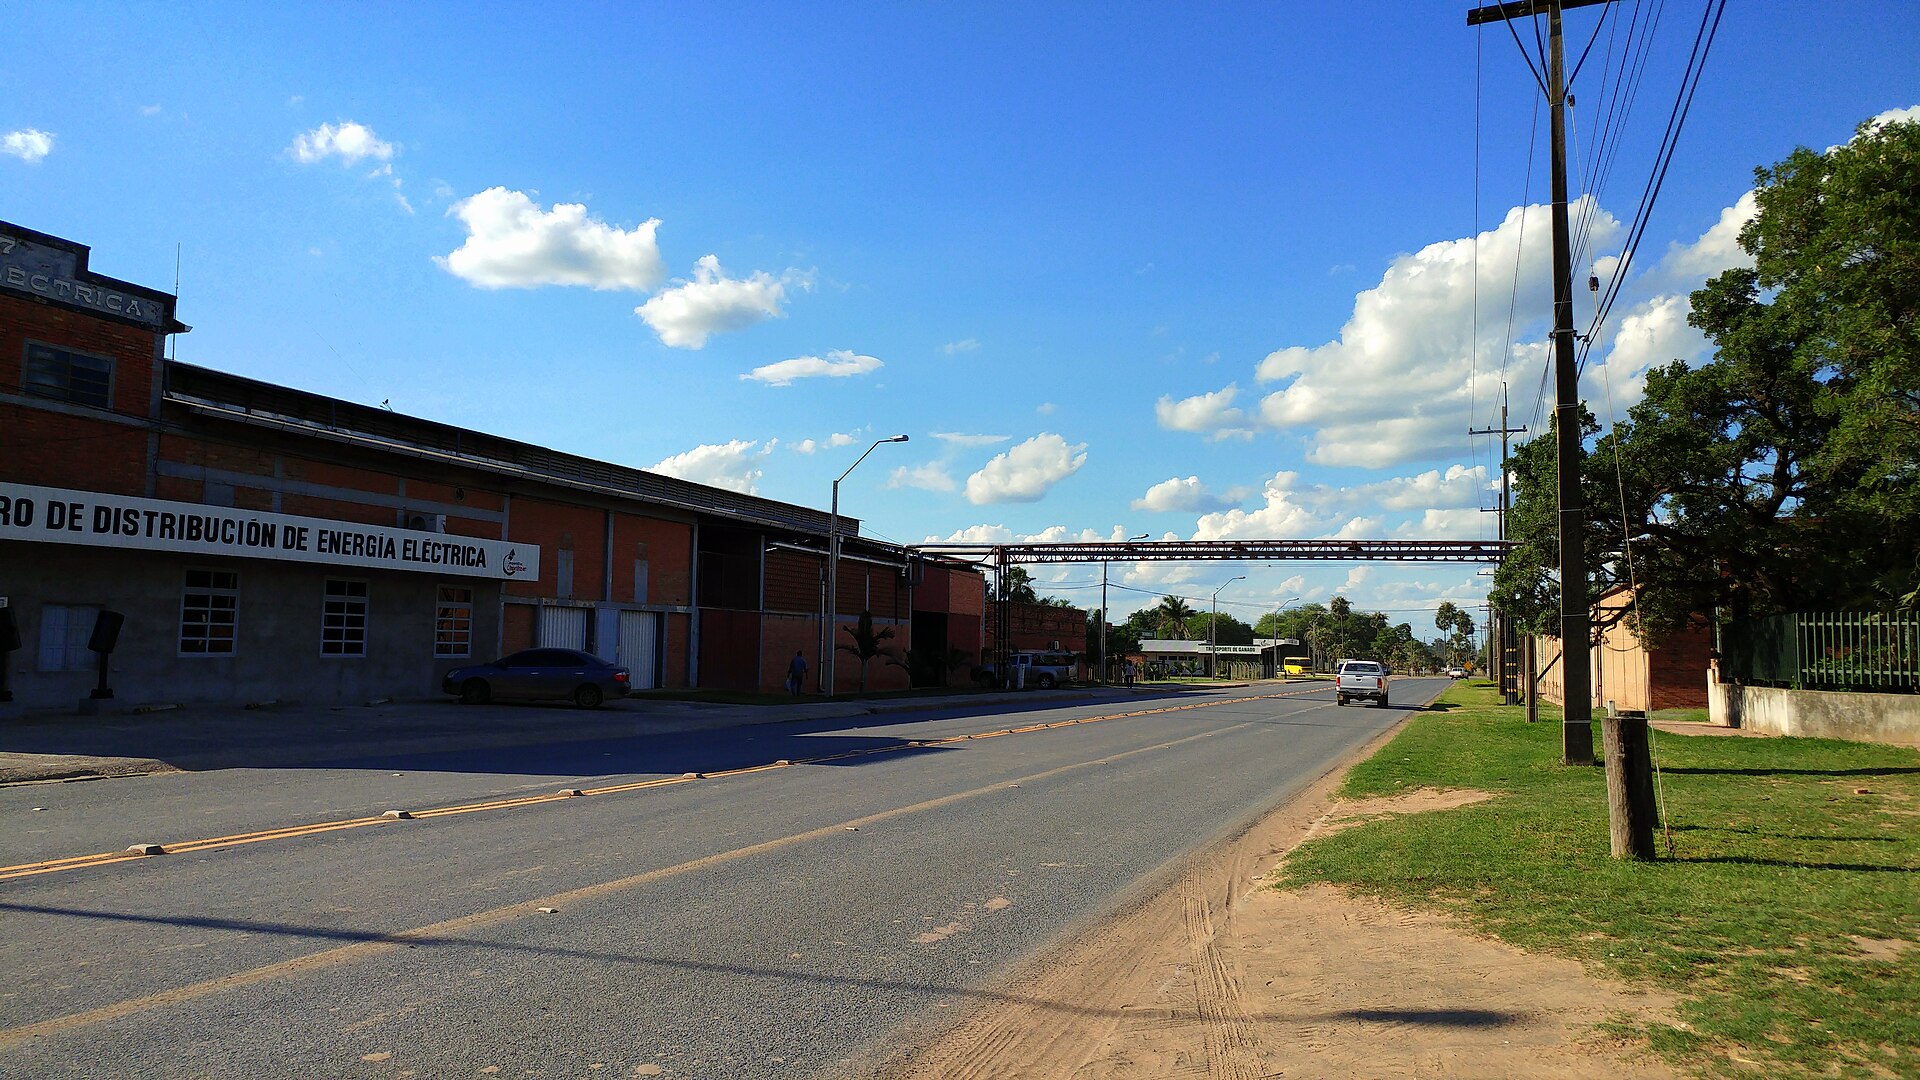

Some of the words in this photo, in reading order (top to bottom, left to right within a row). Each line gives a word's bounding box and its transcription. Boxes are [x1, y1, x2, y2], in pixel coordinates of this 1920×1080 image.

[0, 266, 142, 317] ECTRICA
[46, 500, 84, 531] DE
[92, 505, 277, 548] DISTRIBUCIÓN
[282, 525, 309, 550] DE
[317, 530, 396, 559] ENERGÍA
[402, 538, 486, 568] ELÉCTRICA
